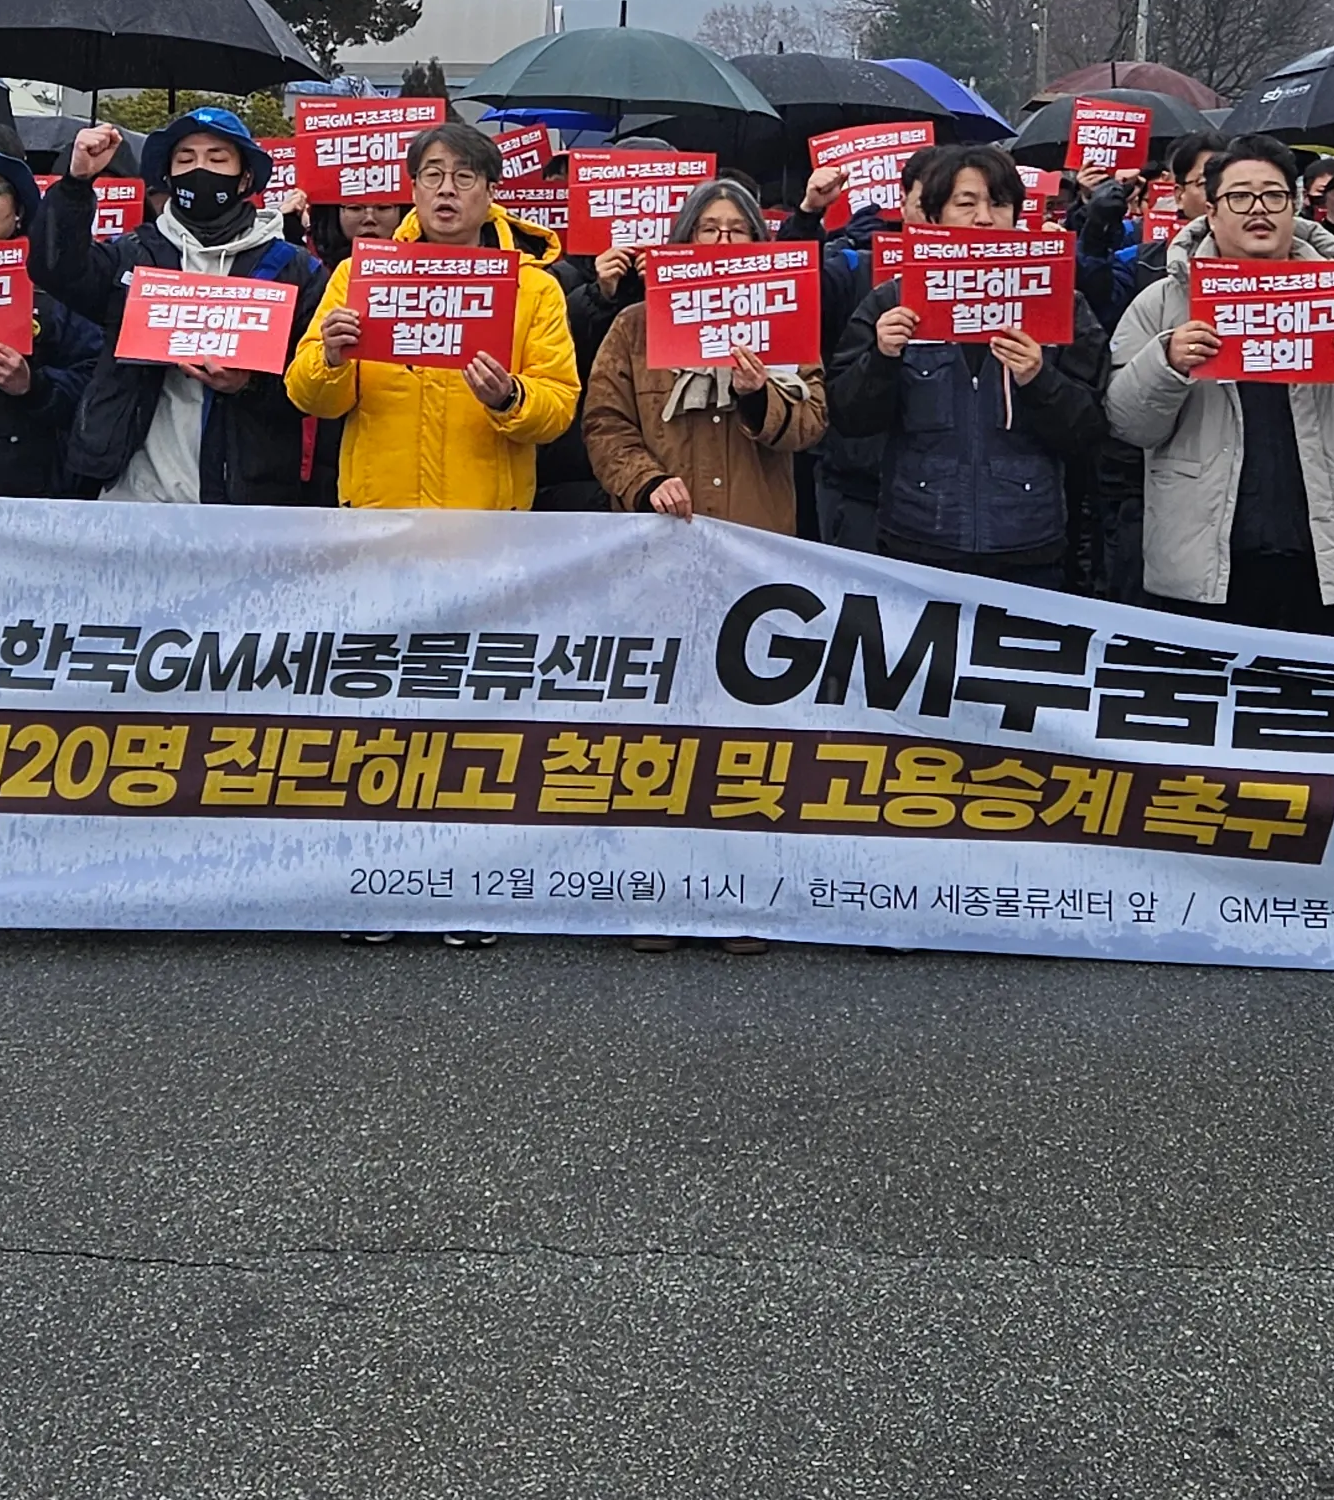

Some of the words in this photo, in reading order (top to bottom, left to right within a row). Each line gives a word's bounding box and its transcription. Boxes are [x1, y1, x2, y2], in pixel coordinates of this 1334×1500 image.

[305, 113, 352, 131] 한국GM
[354, 109, 403, 126] 구조조정
[406, 106, 435, 121] 중단!
[854, 133, 899, 151] 구조조정
[339, 164, 400, 197] 철회!
[578, 166, 625, 181] 한국GM
[627, 162, 675, 177] 구조조정
[677, 161, 707, 176] 중단!
[611, 217, 670, 247] 철회!
[914, 243, 967, 260] 한국GM
[970, 242, 1027, 258] 구조조정
[1030, 240, 1064, 255] 중단!
[361, 259, 413, 276] 한국GM
[415, 259, 471, 275] 구조조정
[474, 259, 509, 274] 중단!
[657, 262, 713, 282] 한국GM
[714, 255, 771, 275] 구조조정
[774, 251, 808, 268] 중단!
[140, 283, 194, 298] 한국GM
[196, 285, 251, 299] 구조조정
[253, 288, 286, 302] 중단!
[925, 266, 1052, 301] 집단해고
[1201, 277, 1257, 294] 한국GM
[1258, 272, 1316, 292] 구조조정
[368, 285, 494, 318] 집단해고
[670, 279, 798, 324] 집단해고
[148, 303, 270, 332] 집단해고
[952, 302, 1023, 334] 철회!
[168, 331, 239, 357] 철회!
[392, 322, 463, 355] 철회!
[699, 320, 770, 359] 철회!
[1242, 338, 1313, 373] 철회!
[200, 726, 524, 811] 집단해고
[537, 731, 700, 815] 철회
[710, 740, 793, 822] 및
[800, 743, 1134, 836] 고용승계
[1143, 775, 1310, 851] 촉구
[350, 868, 455, 898] 2025년
[471, 868, 535, 900] 12월
[548, 870, 667, 902] 29일(월)
[681, 873, 746, 904] 11시
[769, 877, 784, 906] /
[808, 878, 918, 911] 한국GM
[930, 884, 1113, 922] 세종물류센터
[1128, 891, 1159, 924] 앞
[1181, 892, 1196, 926] /
